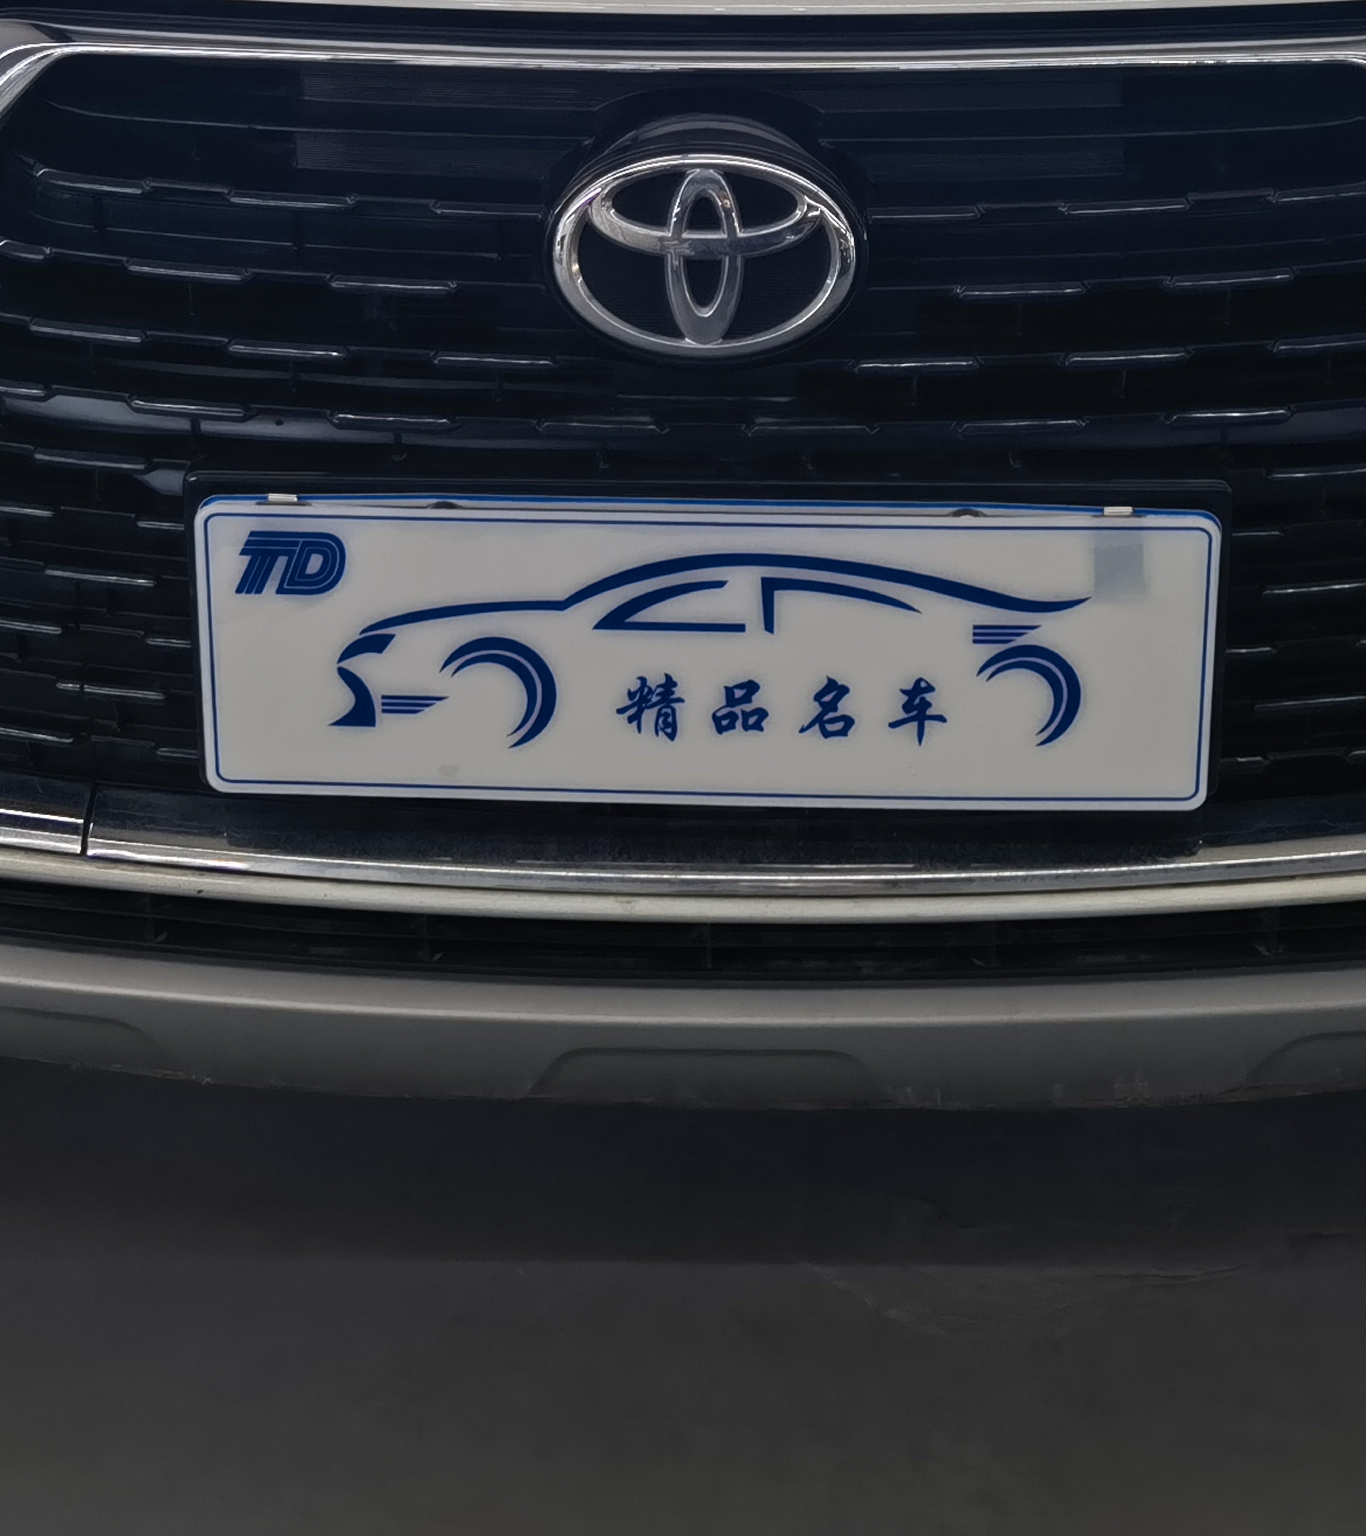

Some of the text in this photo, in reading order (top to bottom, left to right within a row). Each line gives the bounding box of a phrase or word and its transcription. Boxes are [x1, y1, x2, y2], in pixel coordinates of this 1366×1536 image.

[235, 530, 346, 595] TD
[616, 673, 947, 747] 精品名车
